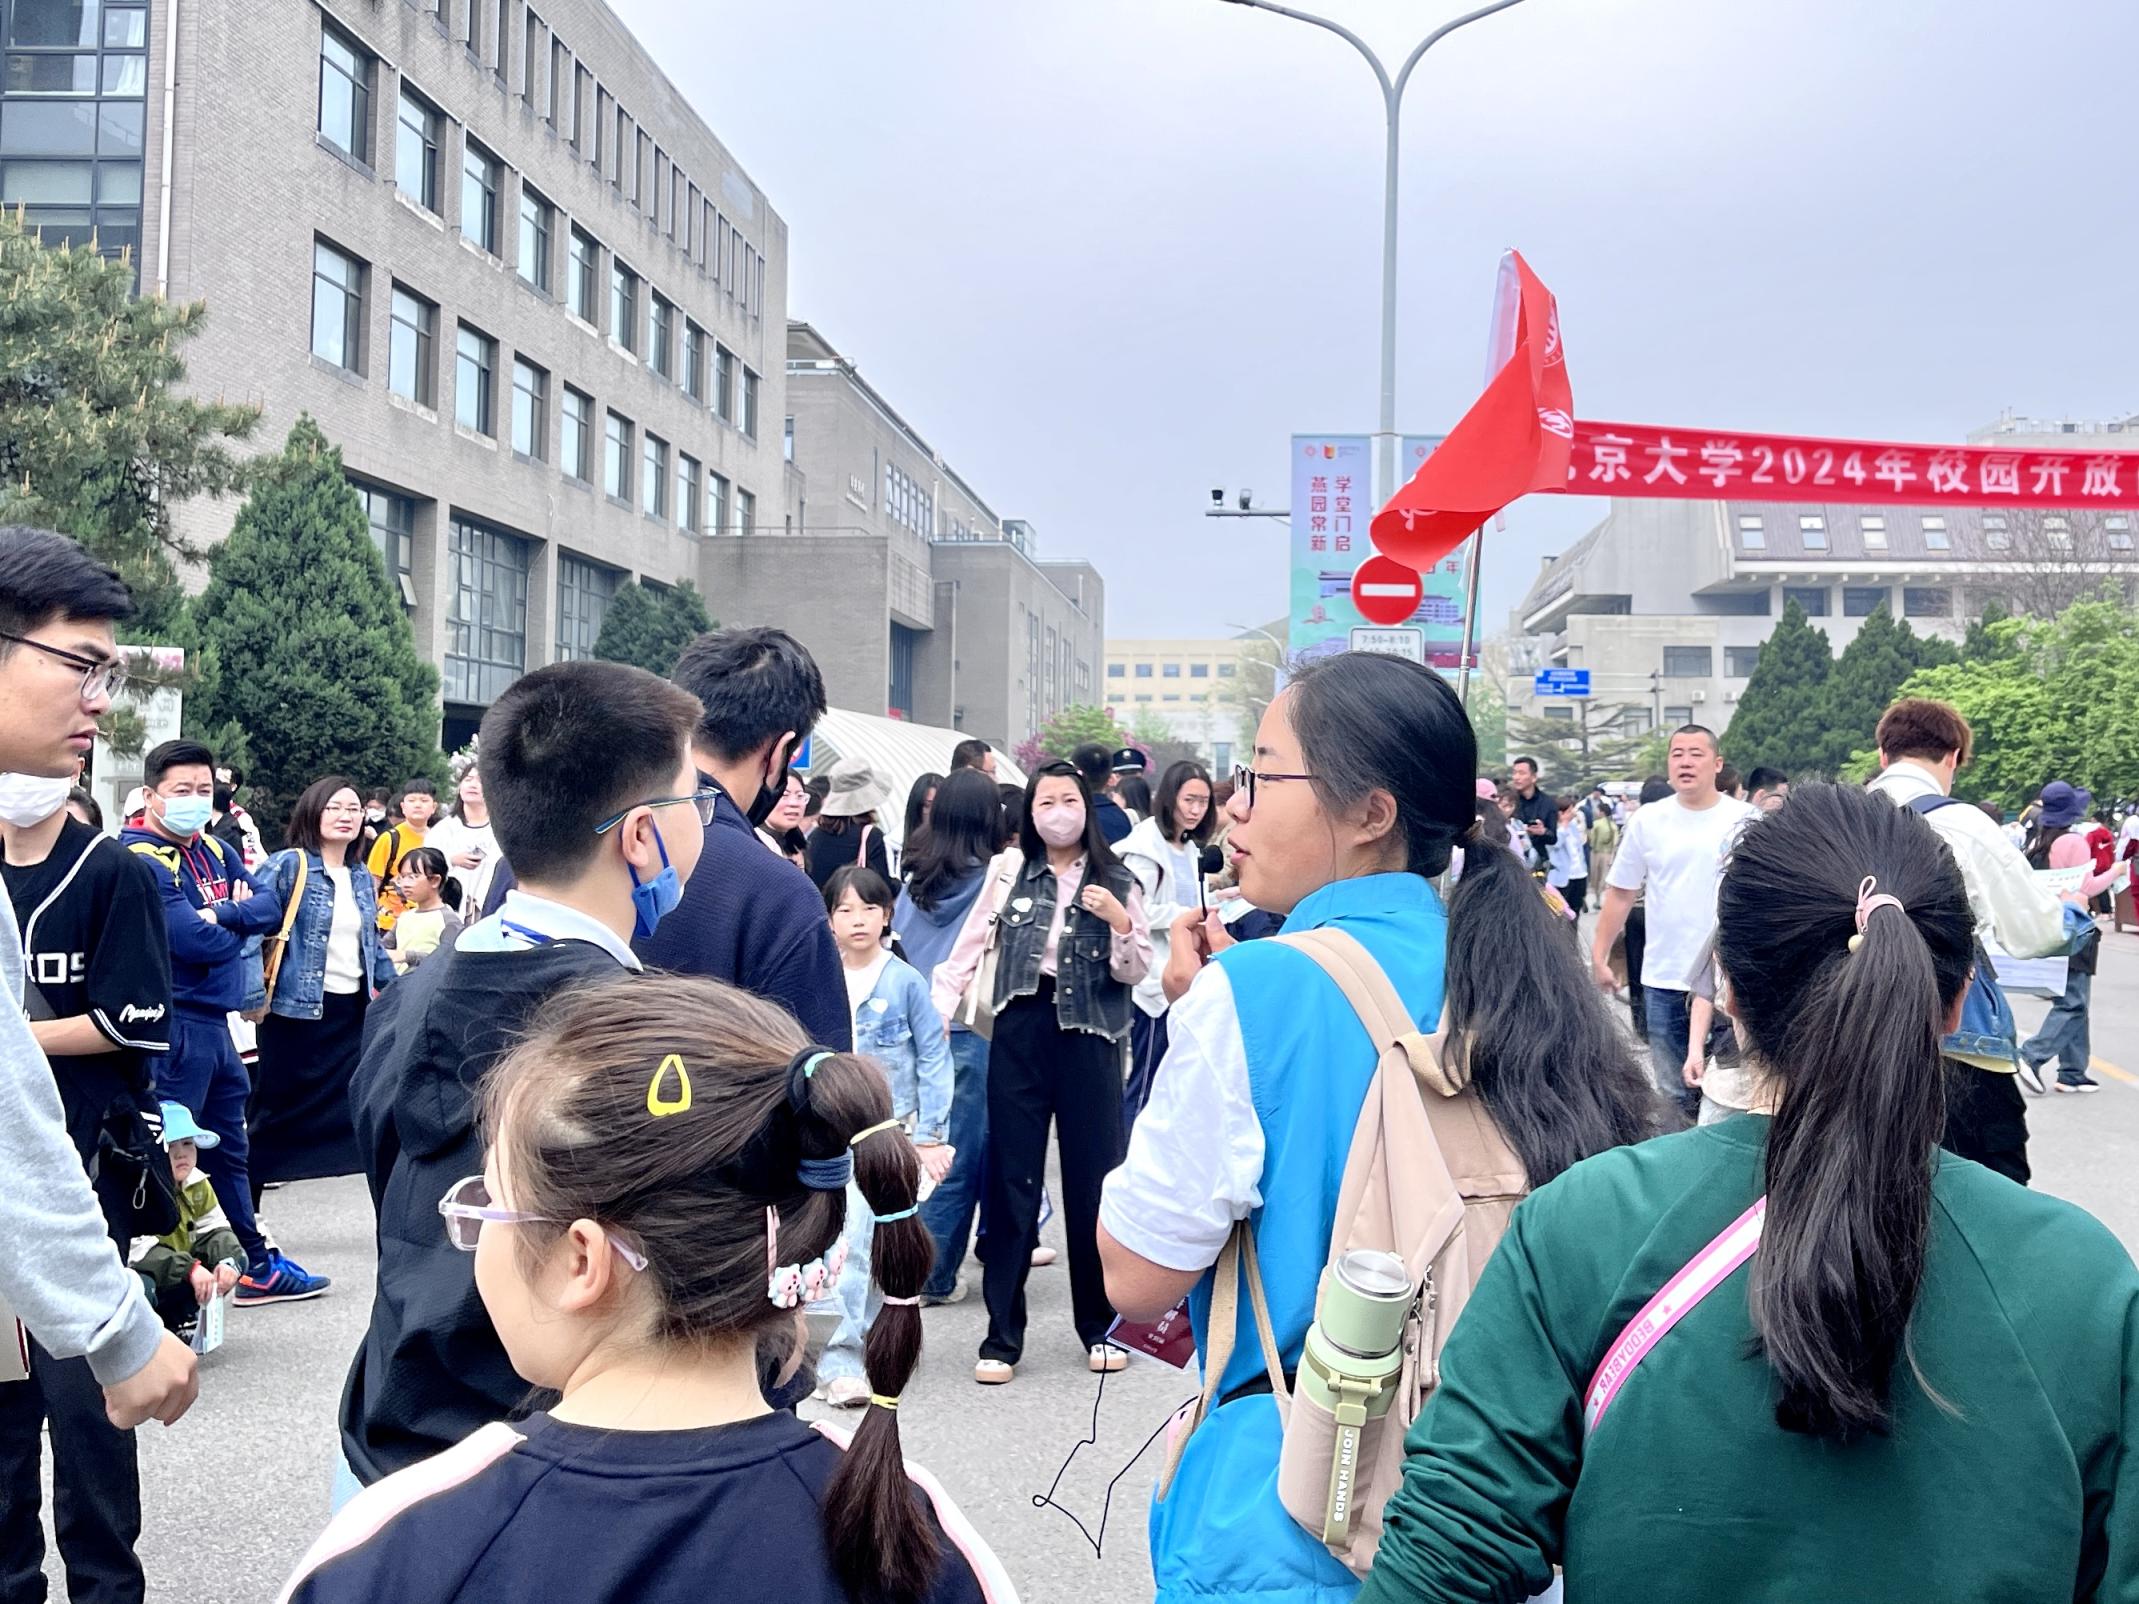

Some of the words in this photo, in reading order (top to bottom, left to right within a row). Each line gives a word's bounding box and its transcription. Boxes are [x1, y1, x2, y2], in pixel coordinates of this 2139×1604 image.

[1568, 434, 2139, 496] 京大学2024年校园开放
[1311, 476, 1328, 552] 燕园常新
[1334, 476, 1351, 552] 学堂门启
[1600, 1318, 1654, 1394] BEDDYBEAR
[1341, 1428, 1354, 1466] JOIN
[1333, 1469, 1350, 1522] HANDS
